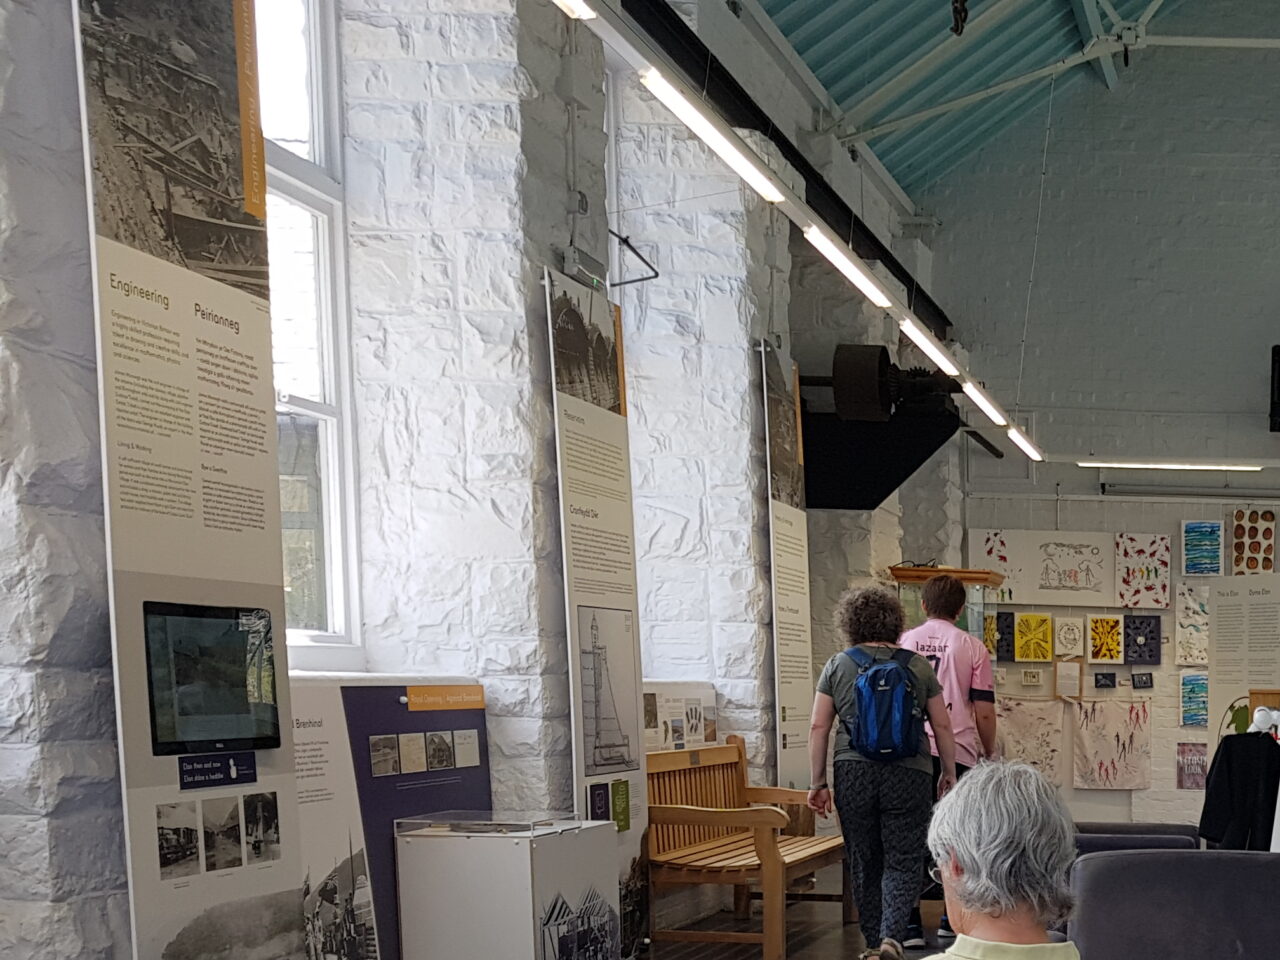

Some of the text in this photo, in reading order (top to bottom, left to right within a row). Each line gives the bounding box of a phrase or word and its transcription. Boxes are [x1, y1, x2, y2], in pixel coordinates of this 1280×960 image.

[109, 272, 170, 310] Engineering
[194, 303, 240, 334] Peirianneg
[916, 641, 948, 653] lazaar
